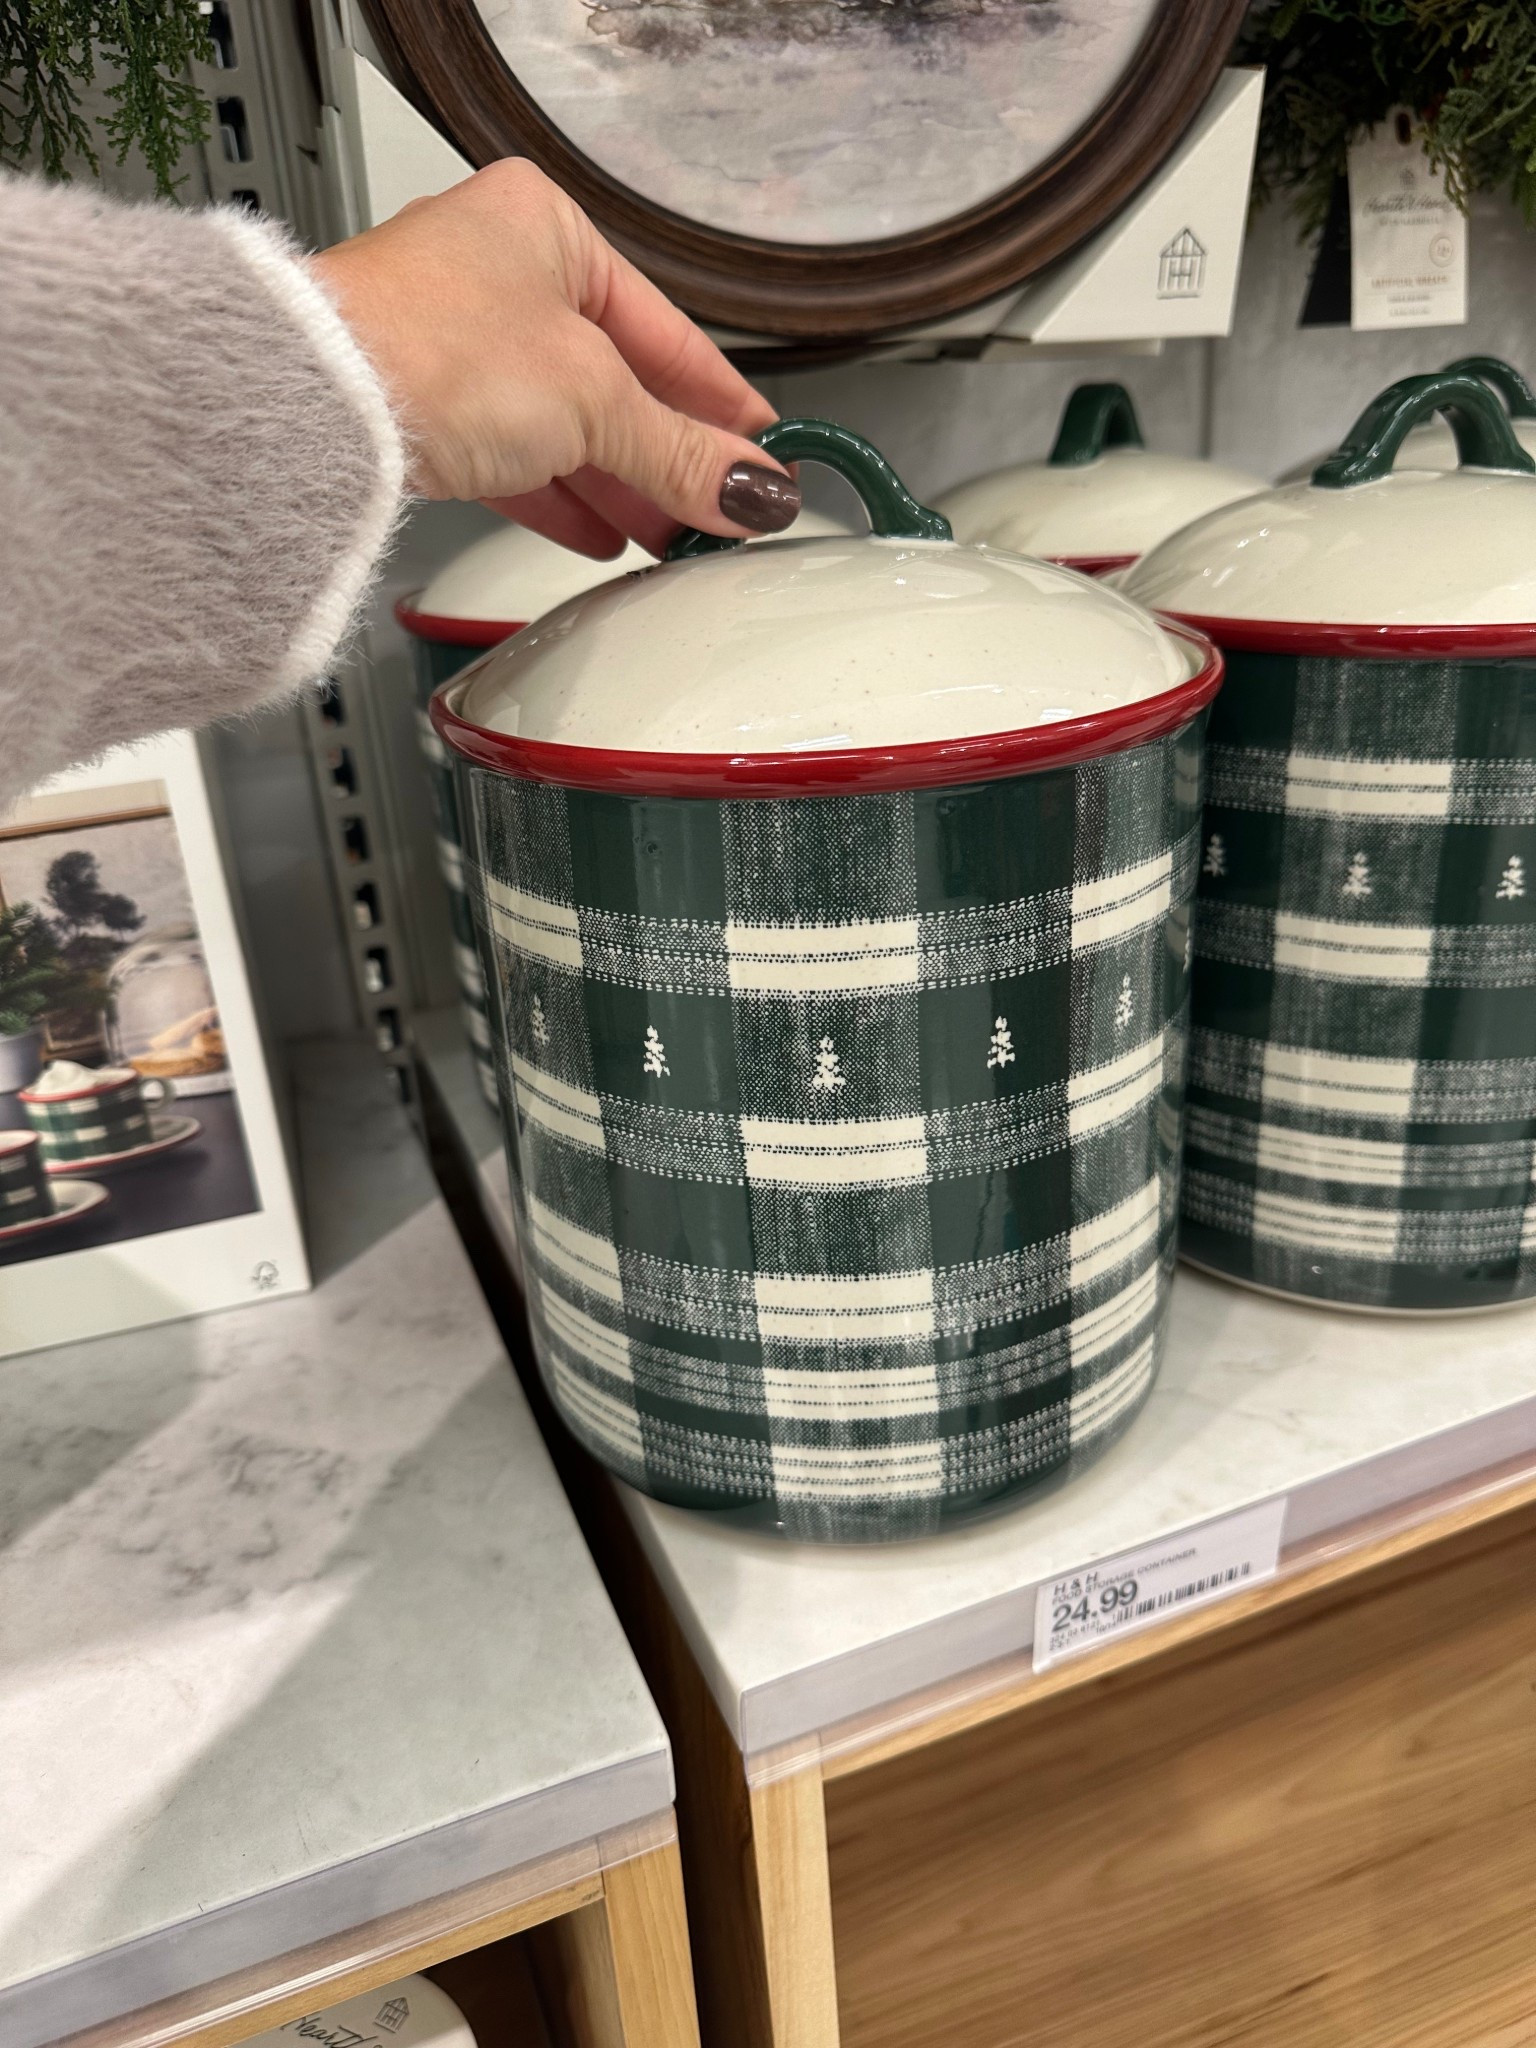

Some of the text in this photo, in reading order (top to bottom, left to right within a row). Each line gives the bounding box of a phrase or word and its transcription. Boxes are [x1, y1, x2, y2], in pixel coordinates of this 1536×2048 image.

[1052, 1547, 1197, 1605] FOOD STORAGE CONTAINER
[1054, 1571, 1098, 1595] H & H
[1051, 1579, 1138, 1632] 24.99
